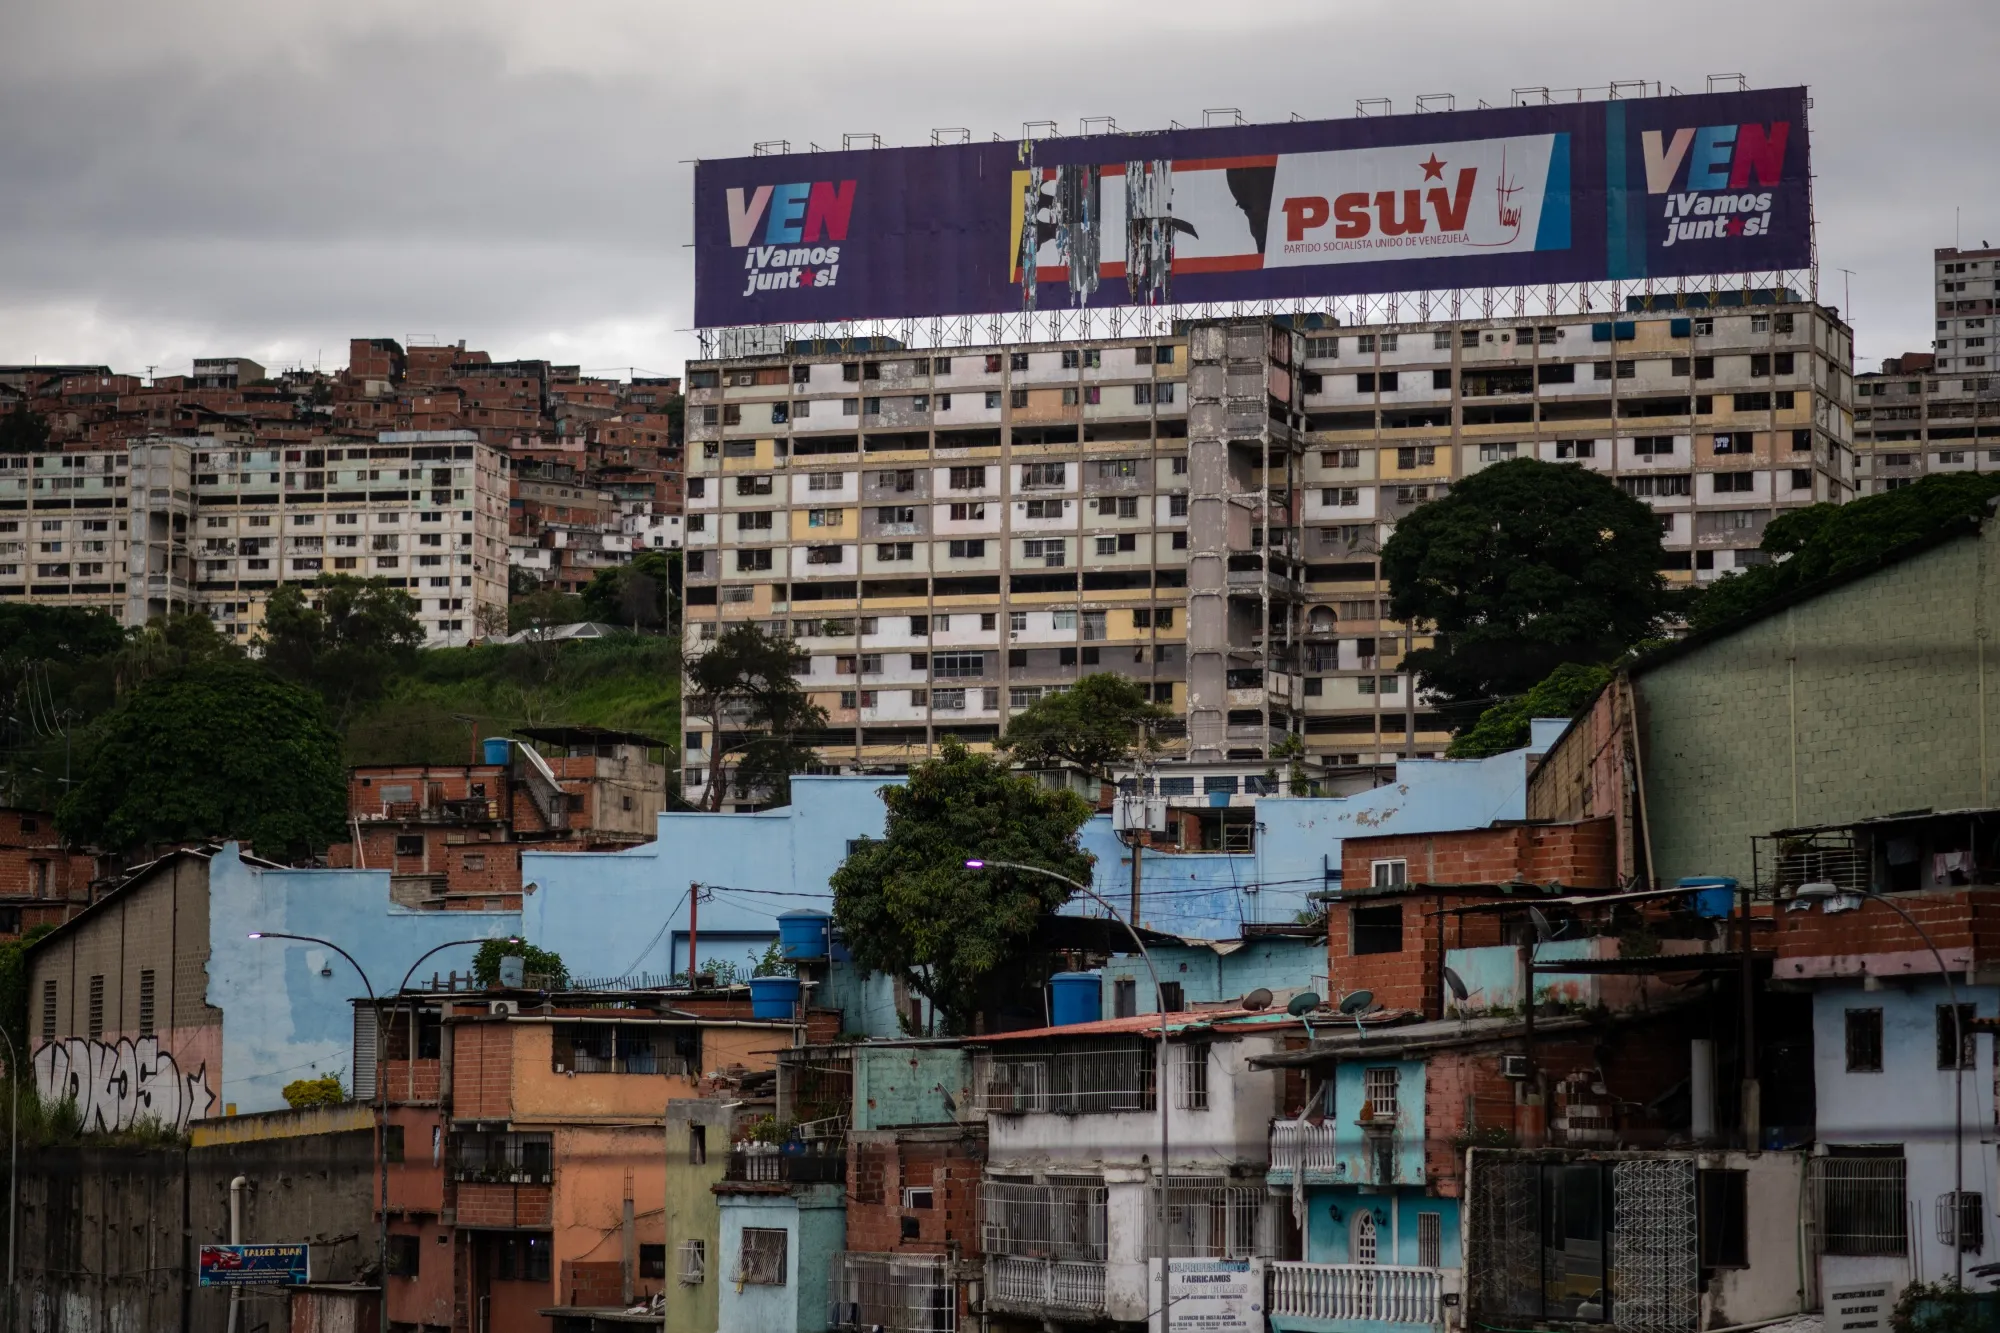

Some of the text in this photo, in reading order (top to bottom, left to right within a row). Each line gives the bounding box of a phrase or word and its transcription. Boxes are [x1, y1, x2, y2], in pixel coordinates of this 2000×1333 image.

[1641, 121, 1790, 194] VEN
[726, 180, 857, 248] VEN
[1281, 167, 1478, 242] PSUV
[1664, 192, 1773, 218] ¡Vamos
[1284, 233, 1470, 254] PARTIDO SOCIALISTA UNIDO DE VENEZUELA
[745, 245, 841, 269] ¡Vamos
[243, 1247, 303, 1257] TALLER JUAN
[1182, 1274, 1231, 1284] FABRICAMOS
